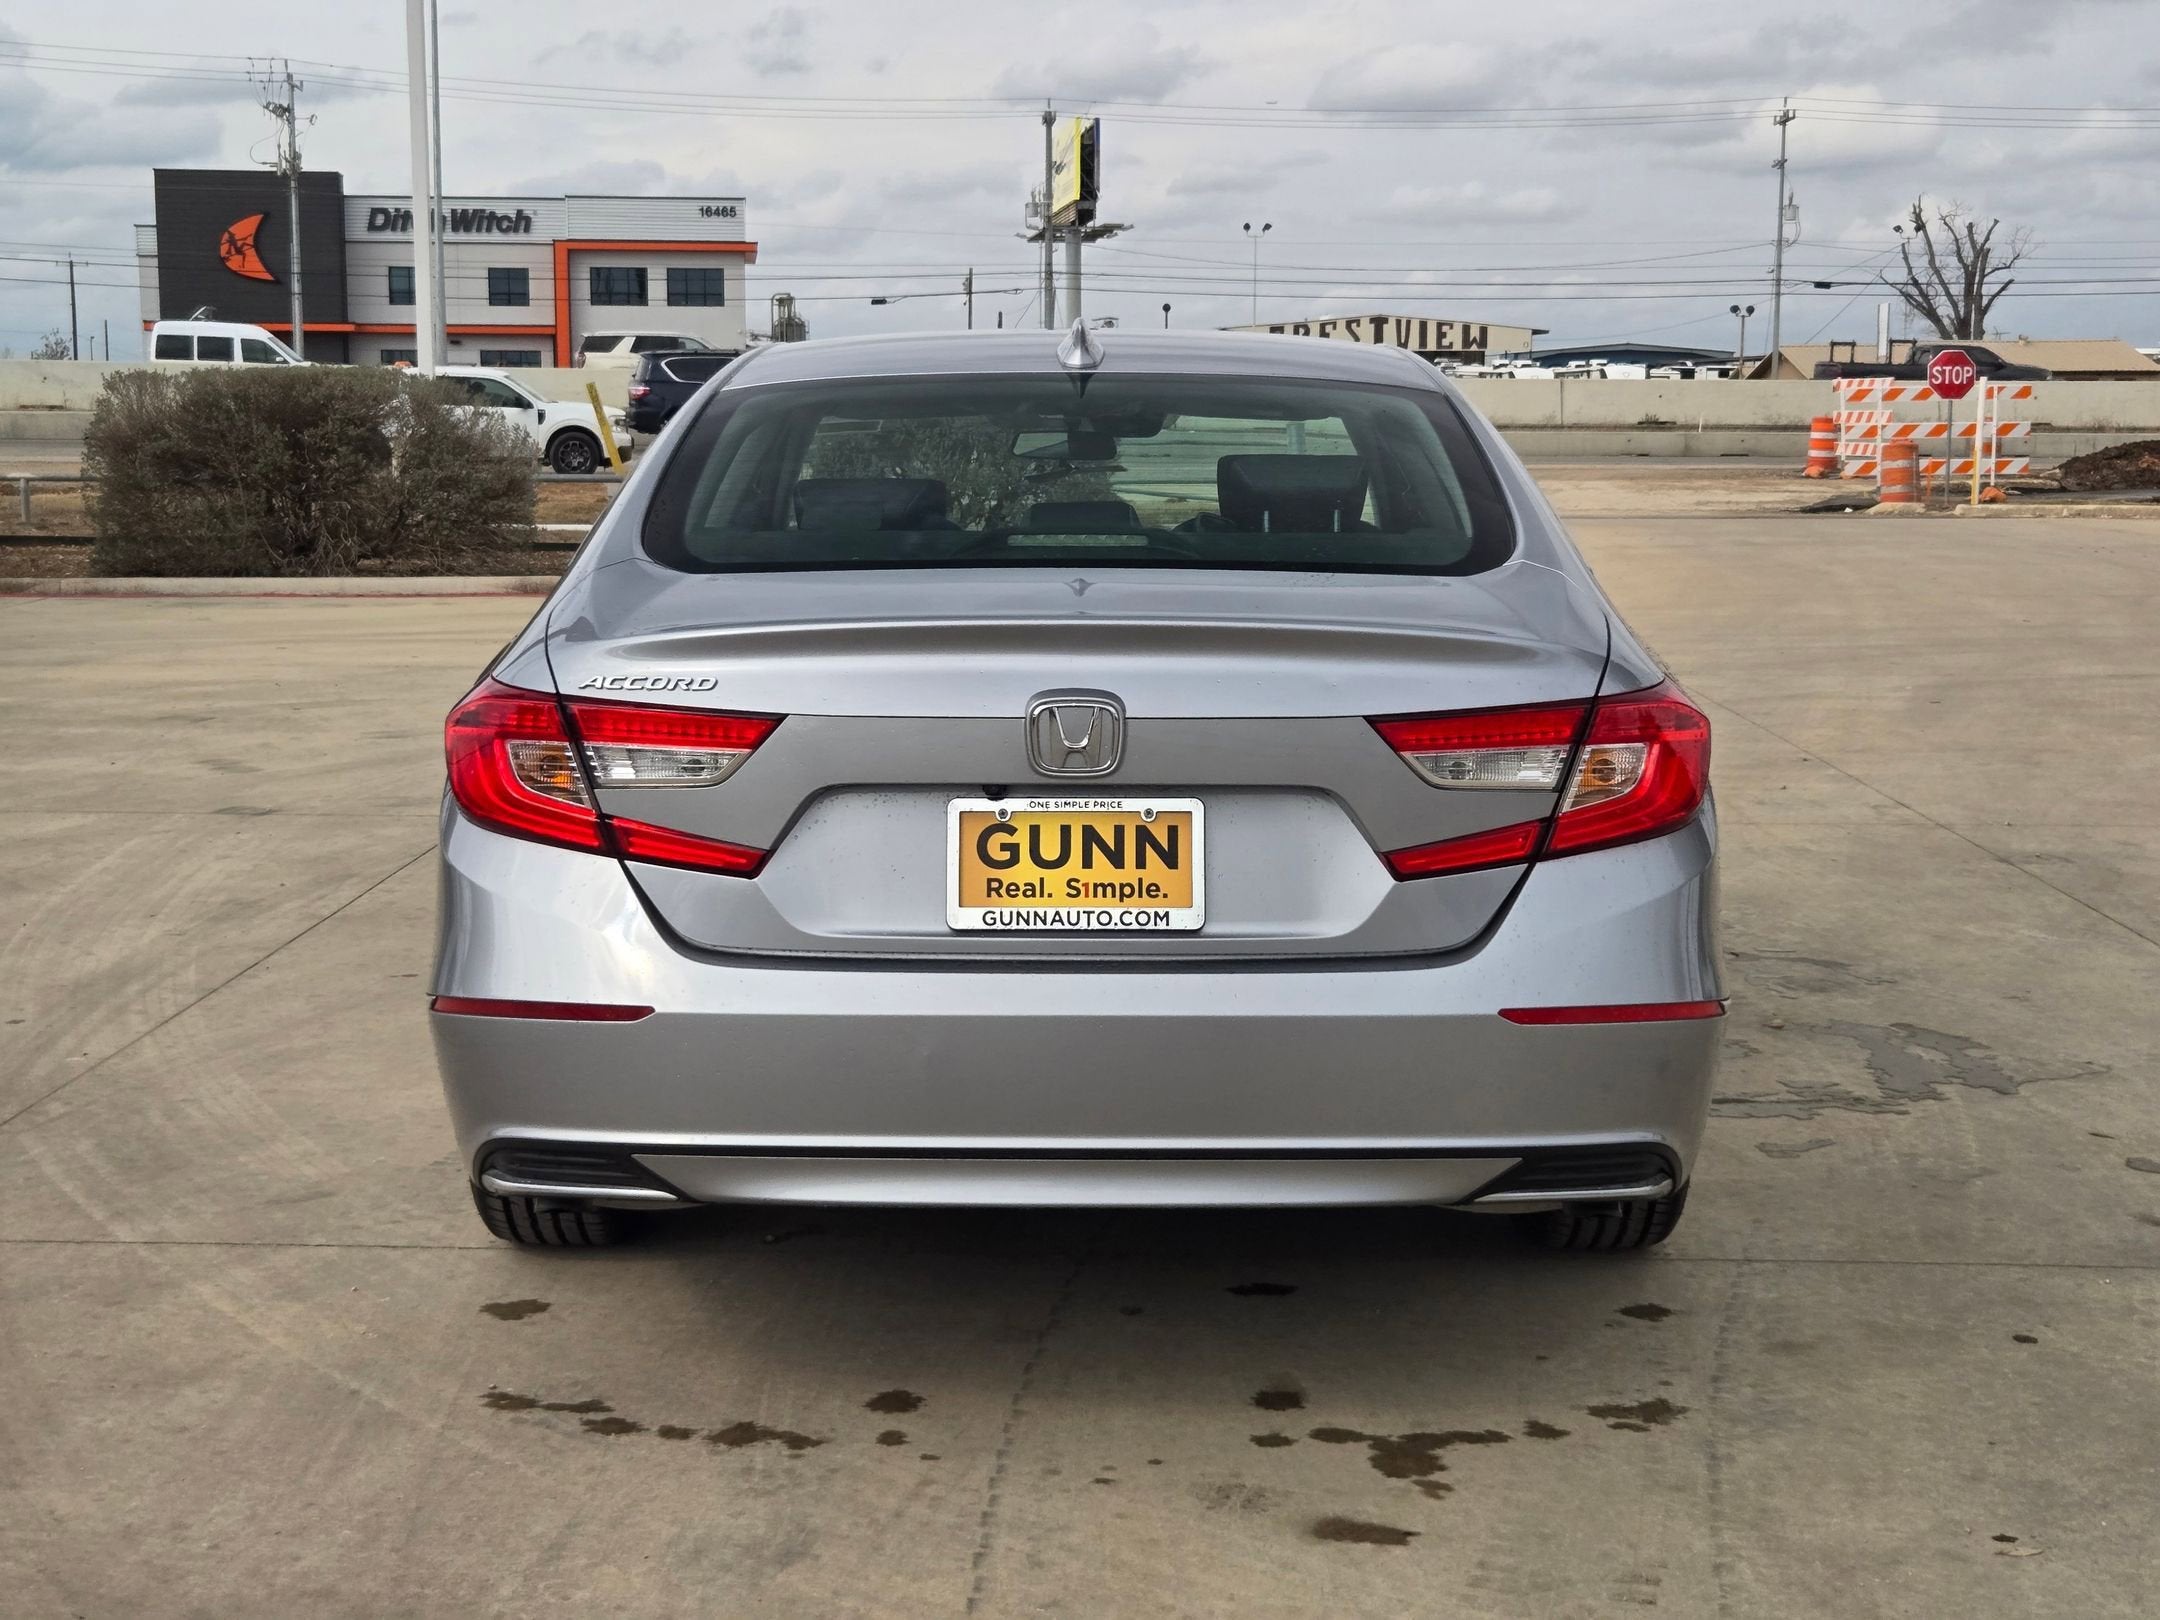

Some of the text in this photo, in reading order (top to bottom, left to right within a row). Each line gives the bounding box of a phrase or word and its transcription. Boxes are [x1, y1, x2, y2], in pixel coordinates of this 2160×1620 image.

[367, 207, 532, 233] Dith Witch
[698, 205, 737, 217] 16465
[1268, 315, 1489, 350] ESTVIEW
[1931, 366, 1973, 385] STOP
[578, 675, 719, 692] ACCORD
[1028, 800, 1124, 809] ONE SIMPLE PRICE
[976, 823, 1179, 870] GUNN
[986, 877, 1053, 899] Real.
[982, 910, 1171, 927] GUNNAUTO.COM
